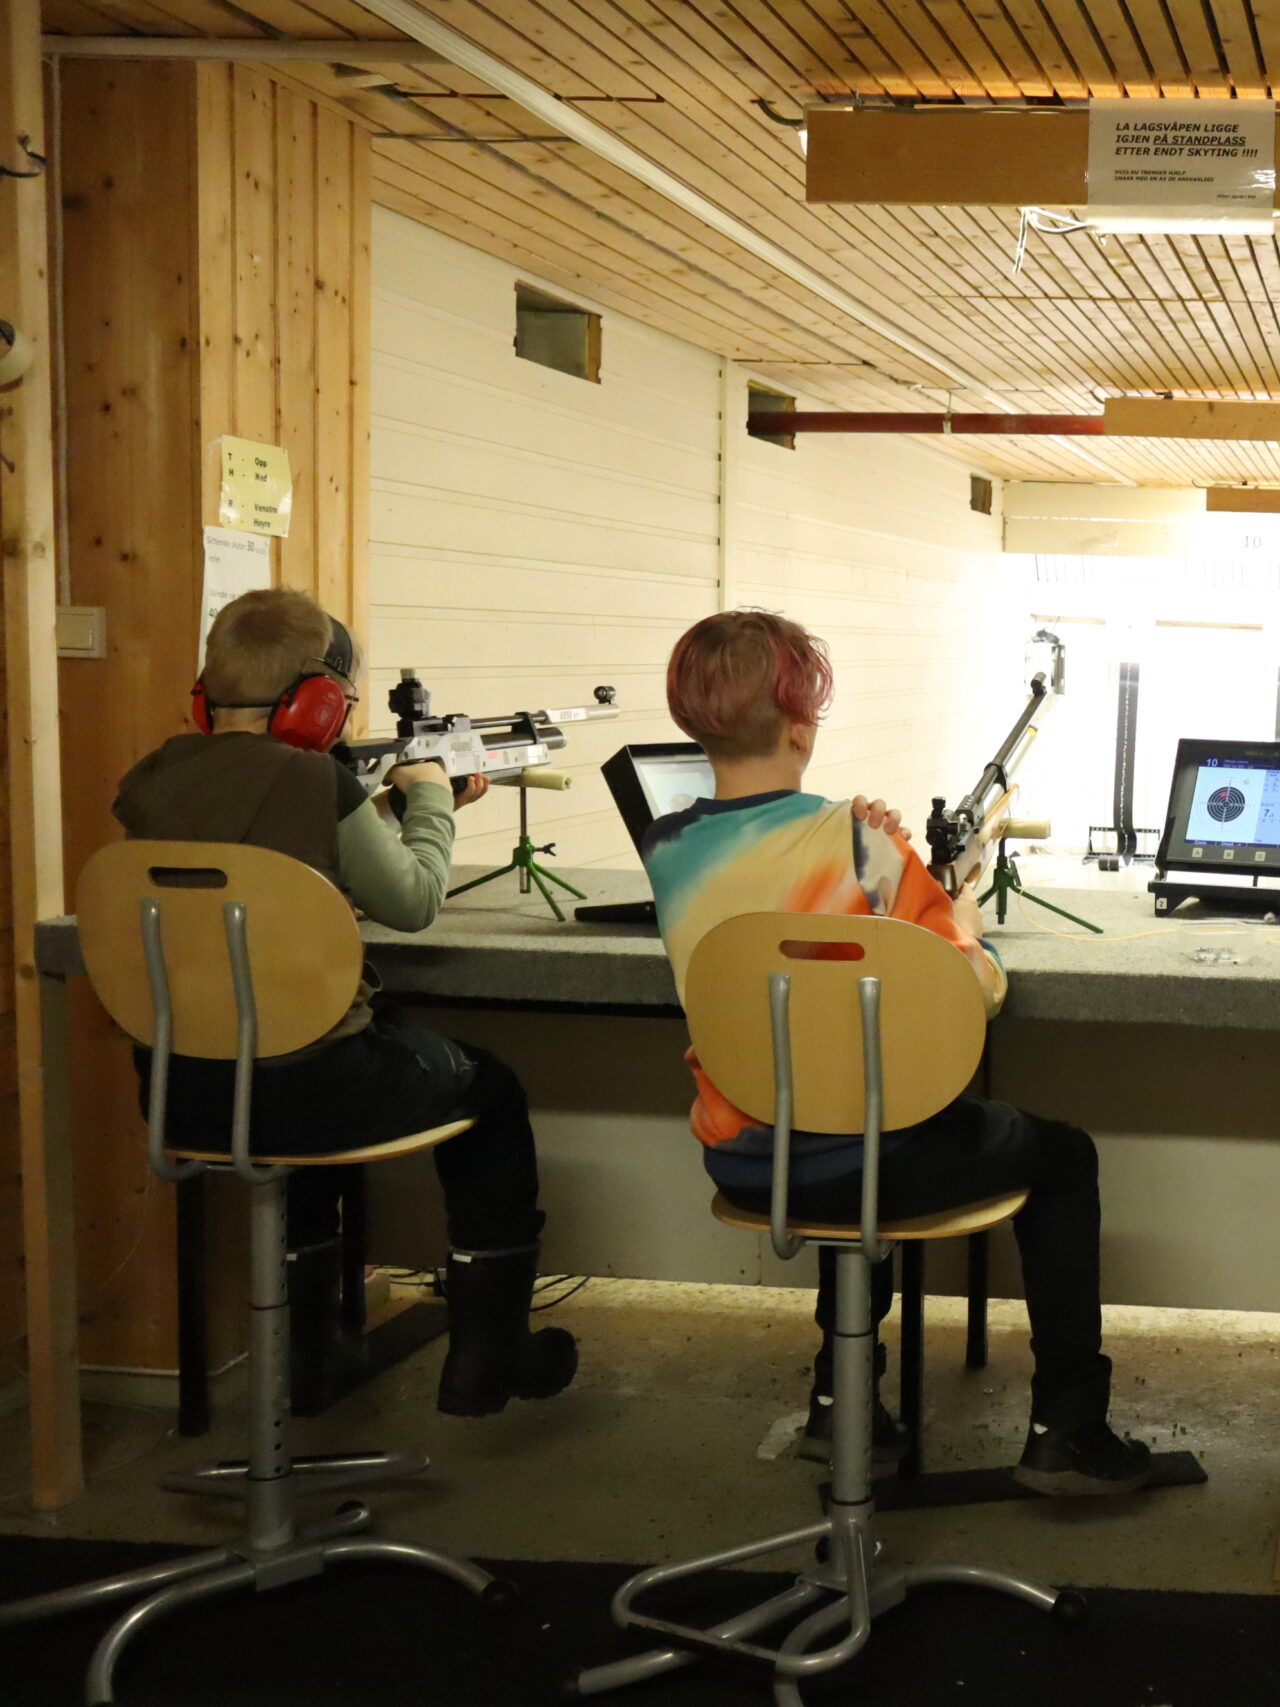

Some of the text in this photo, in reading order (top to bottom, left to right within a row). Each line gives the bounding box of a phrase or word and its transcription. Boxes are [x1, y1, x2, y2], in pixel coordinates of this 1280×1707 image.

[1115, 121, 1240, 133] LA LAGSVÅPEN LIGGE
[1115, 133, 1247, 146] IGJEN PÅ STANDPLASS
[1115, 146, 1151, 156] ETTER
[1153, 147, 1185, 156] ENDT
[1187, 147, 1239, 157] SKYTING
[227, 452, 233, 461] T
[254, 456, 268, 469] Opp
[228, 468, 235, 477] H
[253, 502, 279, 514] Venstre
[247, 540, 255, 553] 30
[1243, 535, 1263, 549] 10
[1206, 758, 1218, 767] 10
